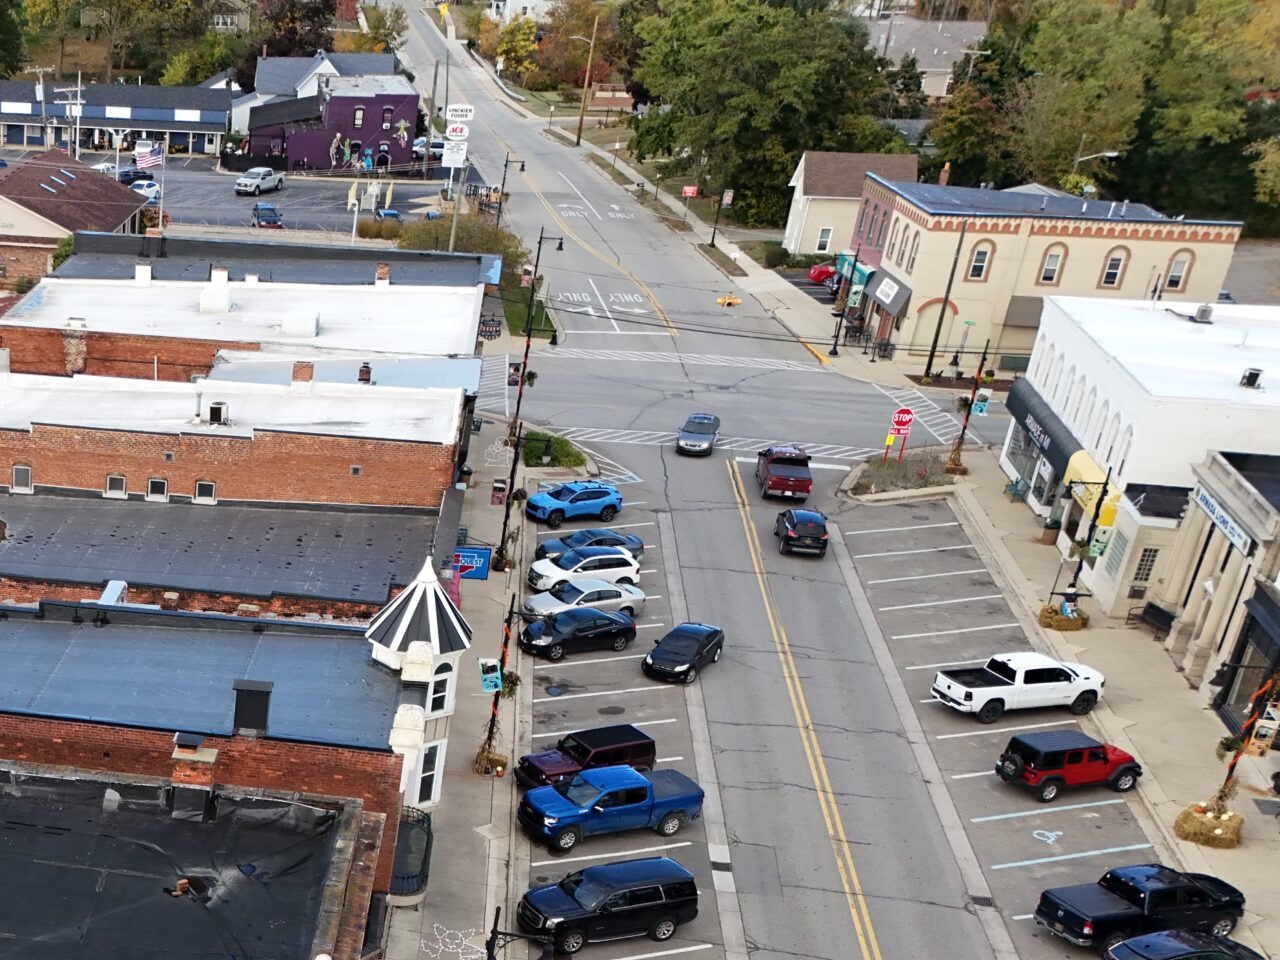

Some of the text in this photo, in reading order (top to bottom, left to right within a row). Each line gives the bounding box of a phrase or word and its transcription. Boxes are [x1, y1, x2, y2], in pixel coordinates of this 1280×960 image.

[451, 126, 465, 134] ACE
[560, 210, 589, 218] ONLY
[607, 211, 635, 219] ONLY
[557, 292, 591, 302] ONLY
[609, 293, 643, 303] ONLY
[893, 413, 913, 422] STOP
[1200, 493, 1229, 530] ARMADA LIONS
